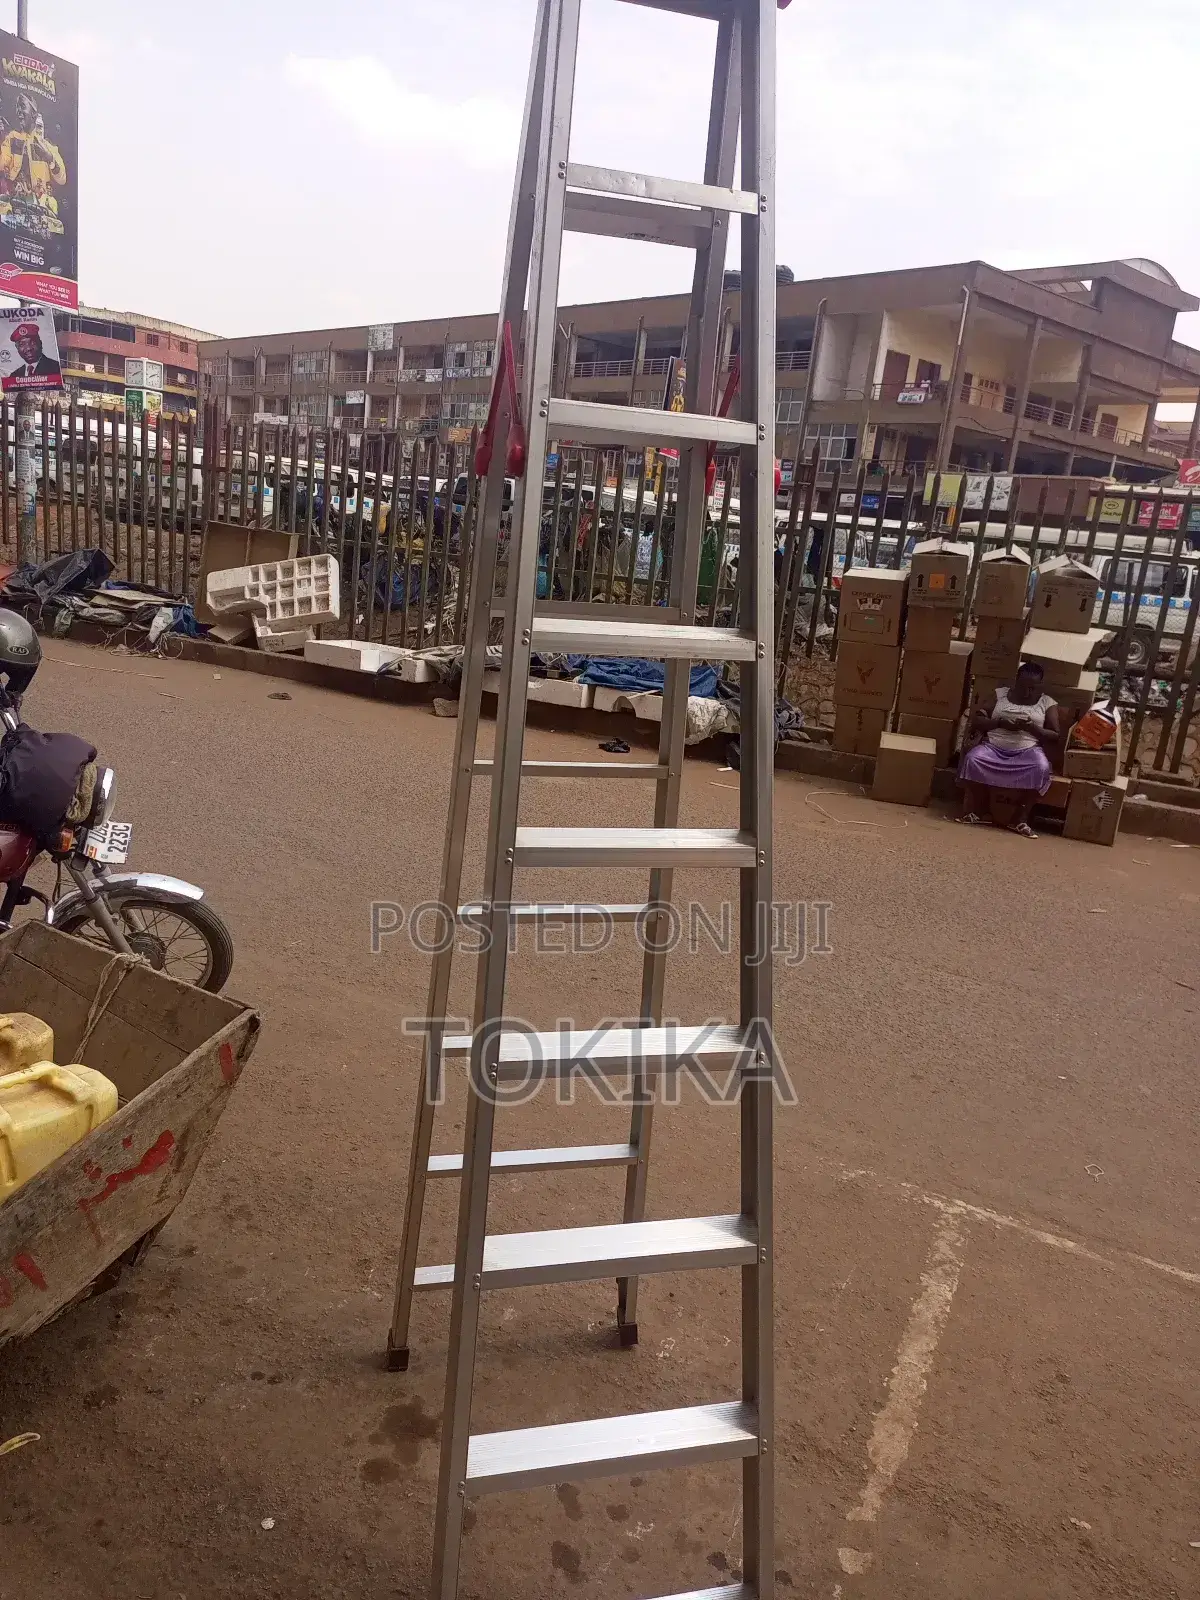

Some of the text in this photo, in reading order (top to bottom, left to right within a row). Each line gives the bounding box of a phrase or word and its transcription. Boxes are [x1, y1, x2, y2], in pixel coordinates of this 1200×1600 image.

[14, 249, 29, 261] WIN
[31, 254, 44, 265] BIG
[107, 825, 130, 853] 223C
